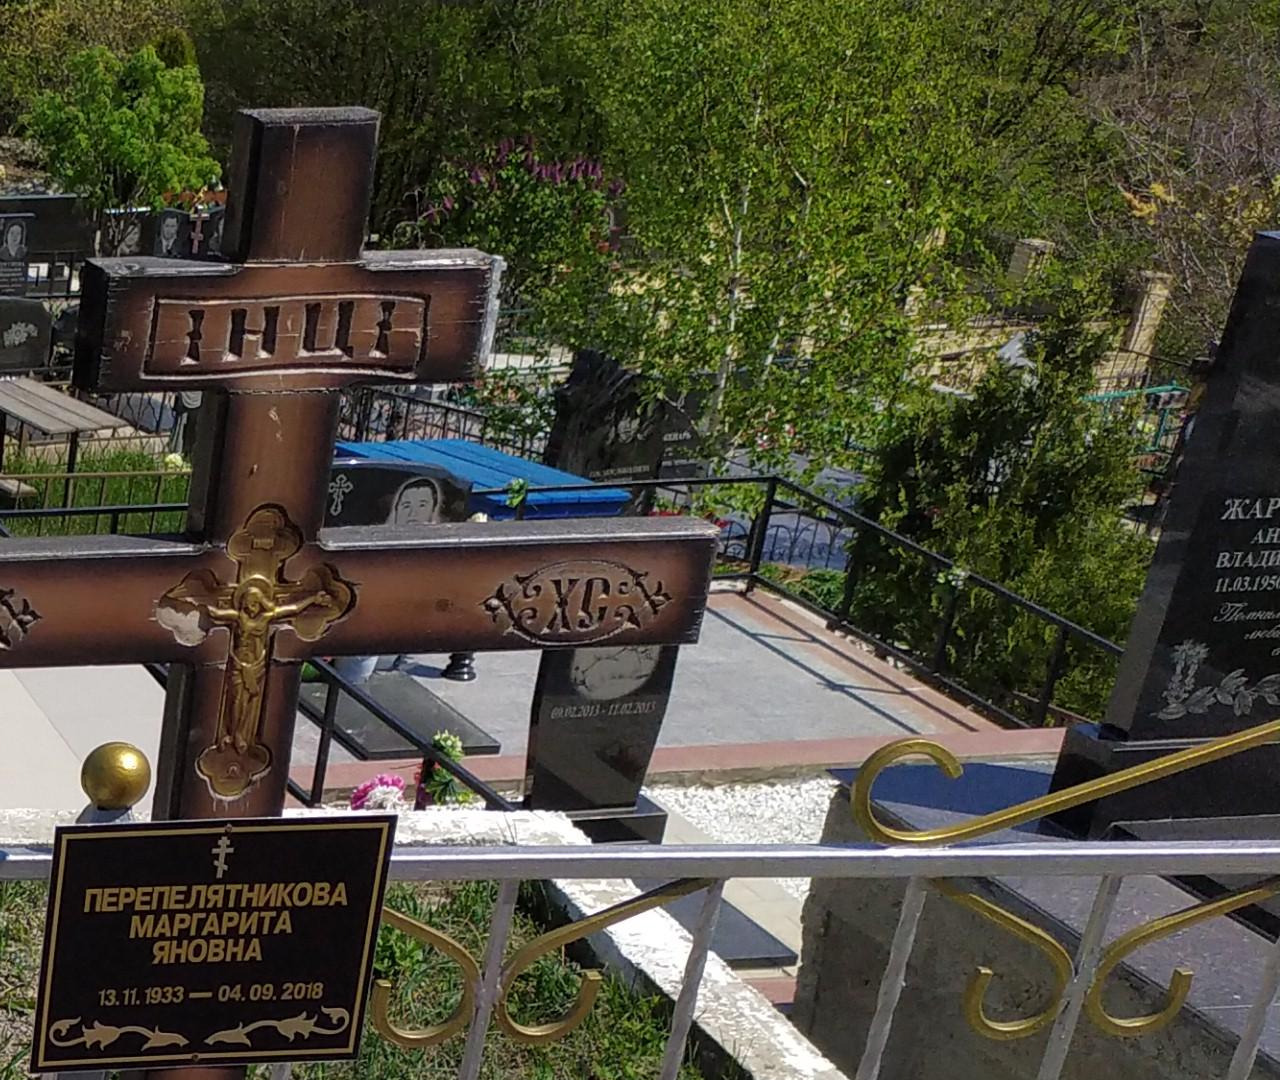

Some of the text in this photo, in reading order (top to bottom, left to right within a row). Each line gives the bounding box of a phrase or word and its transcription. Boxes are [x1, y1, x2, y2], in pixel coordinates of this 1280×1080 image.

[83, 882, 348, 913] ПЕРЕПЕЛЯТНИКОВА
[129, 910, 293, 939] МАРГАРИТА
[151, 937, 263, 965] ЯНОВНА
